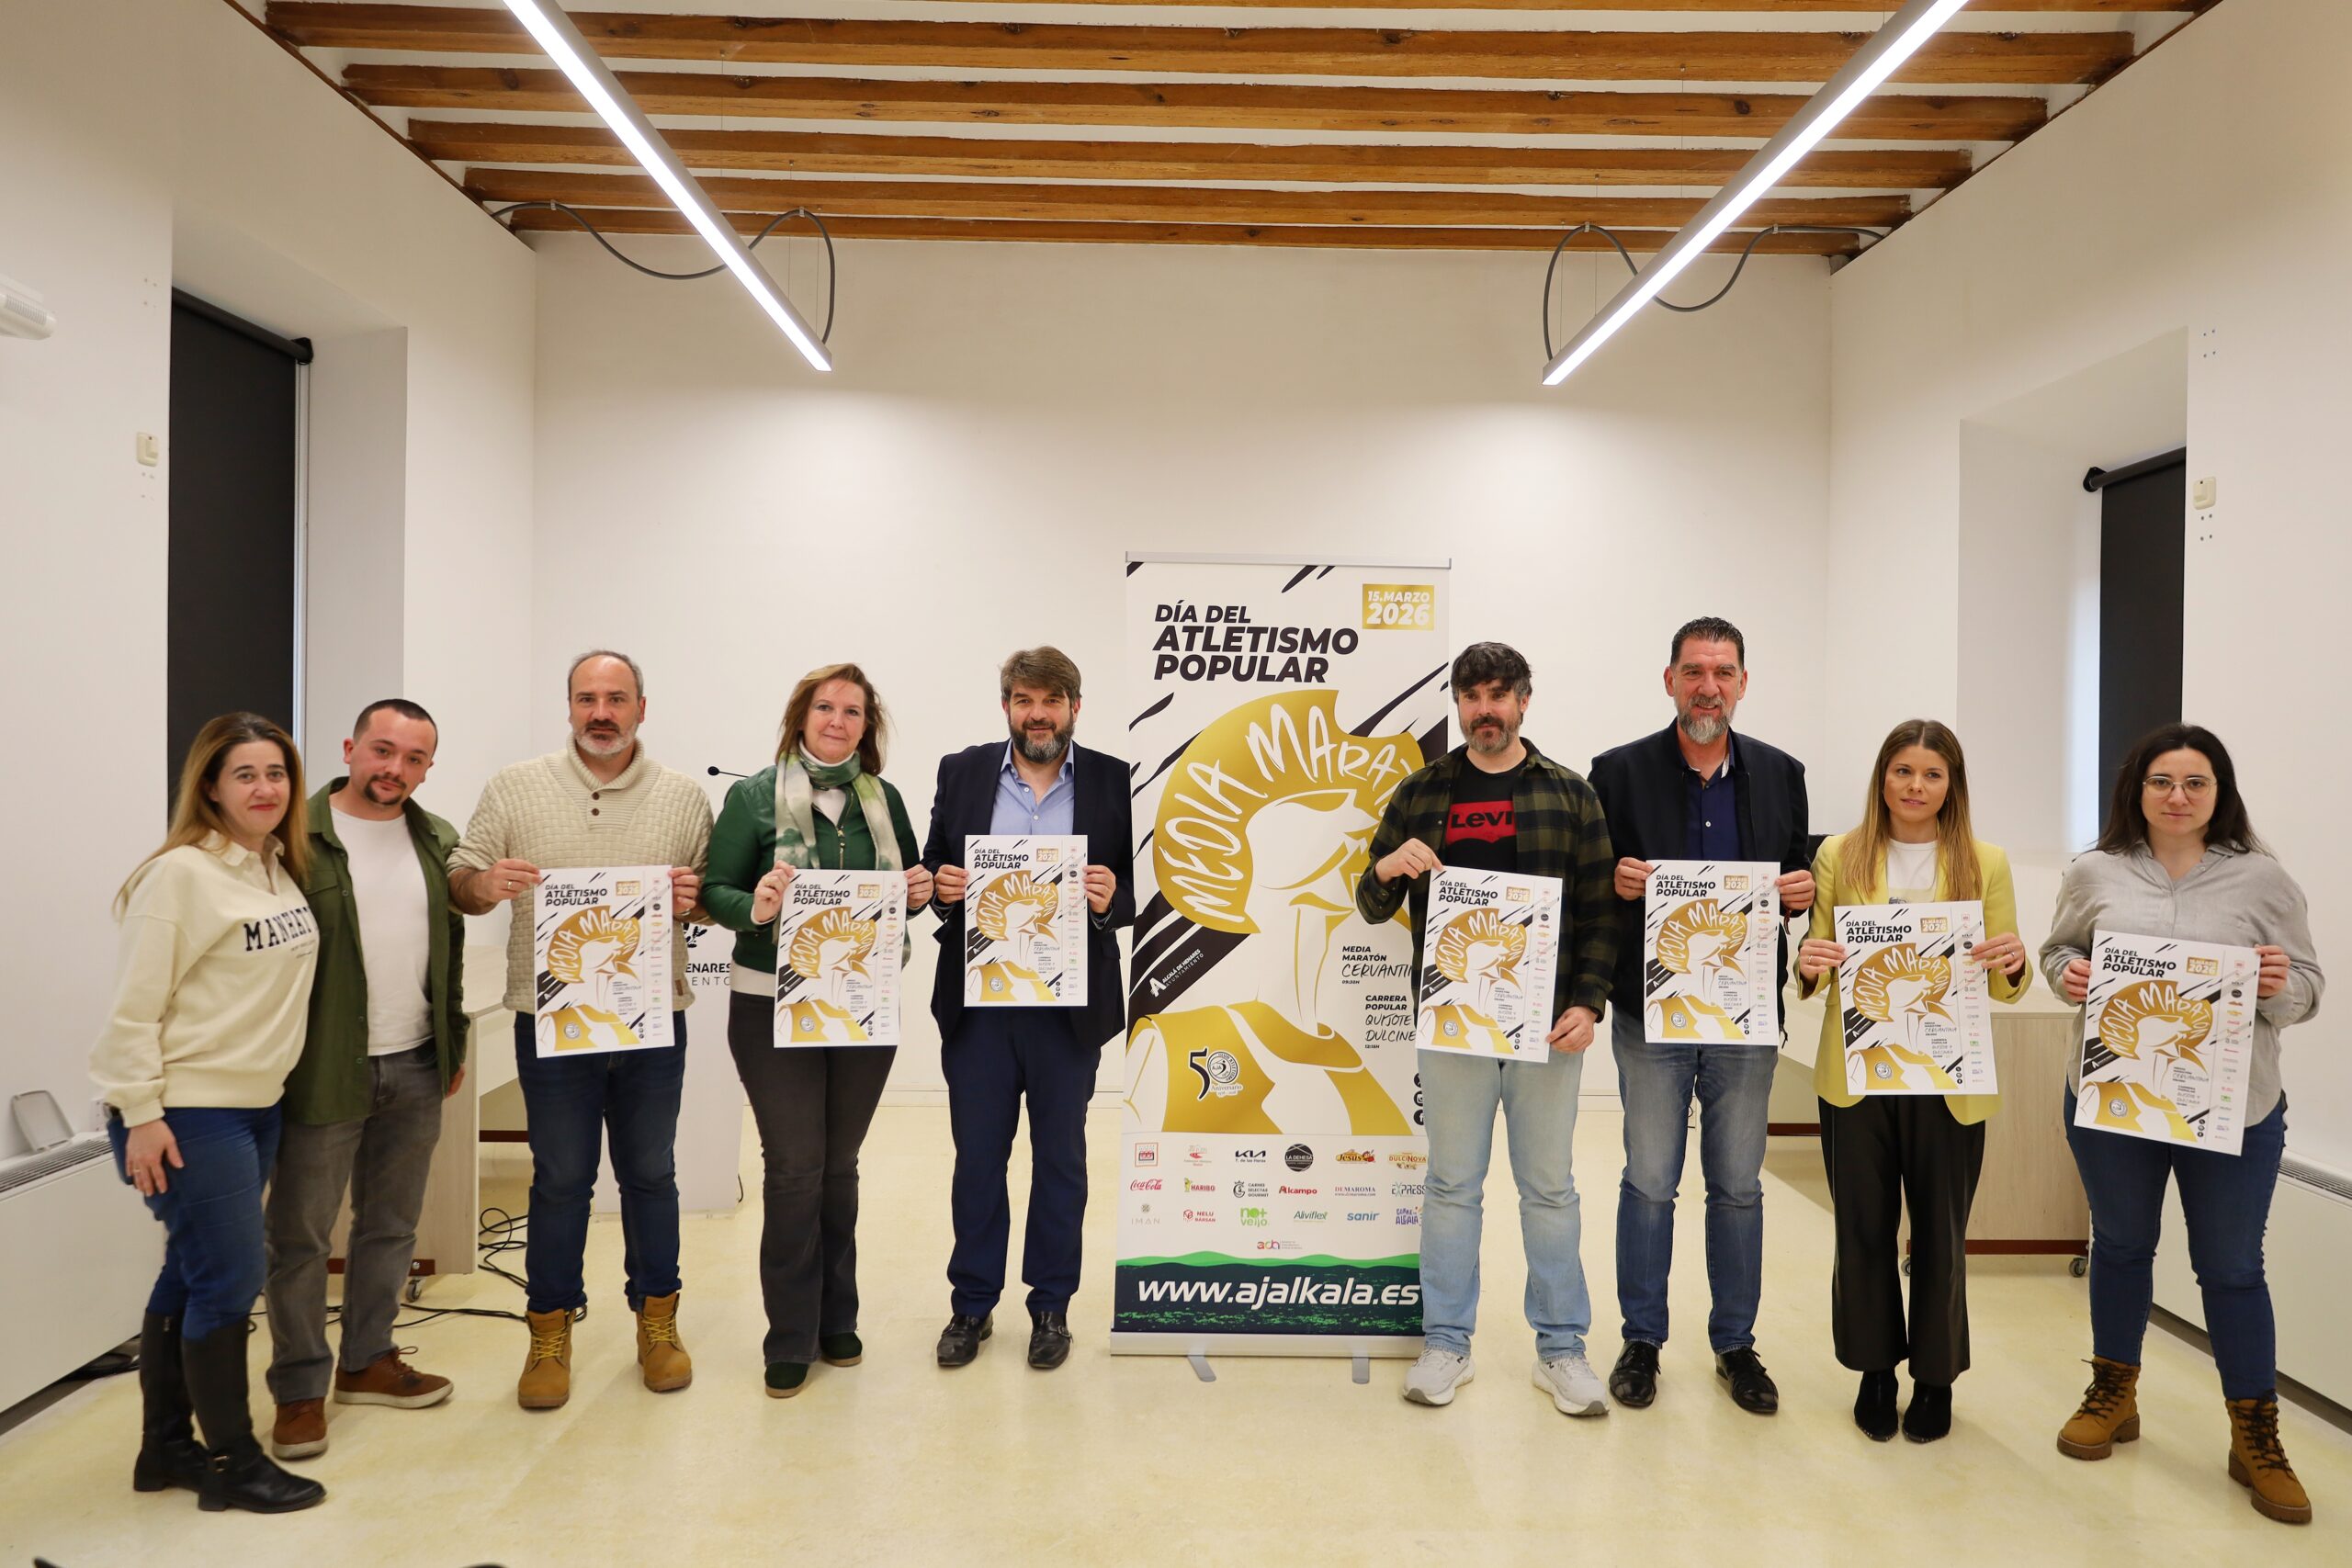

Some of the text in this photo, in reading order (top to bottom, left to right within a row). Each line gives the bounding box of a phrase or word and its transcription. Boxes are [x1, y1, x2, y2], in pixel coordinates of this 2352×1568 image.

[1368, 591, 1430, 603] 15.MARZO
[1155, 600, 1251, 624] DÍA DEL
[1366, 602, 1430, 626] 2026
[1153, 625, 1358, 655] ATLETISMO
[1154, 654, 1329, 683] POPULAR
[1159, 759, 1269, 923] MEDIA
[1656, 880, 1716, 889] ATLETISMO
[545, 888, 607, 898] ATLETISMO
[794, 889, 851, 898] ATLETISMO
[1439, 886, 1498, 899] ATLETISMO
[1656, 889, 1708, 897] POPULAR
[545, 897, 599, 907] POPULAR
[793, 897, 842, 906] POPULAR
[1438, 895, 1489, 907] POPULAR
[978, 890, 1011, 940] MEDIA
[1846, 919, 1860, 928] DÍA
[1846, 925, 1912, 935] ATLETISMO
[1922, 923, 1947, 932] 2026
[1847, 933, 1903, 944] POPULAR
[791, 927, 827, 977] MEDIA
[1657, 919, 1695, 973] MEDIA
[2105, 946, 2138, 957] DÍA DEL
[548, 929, 589, 982] MEDIA
[1342, 953, 1387, 962] MARATÓN
[1436, 927, 1474, 982] MEDIA
[685, 963, 730, 973] ENARES
[2102, 953, 2177, 971] ATLETISMO
[1166, 953, 1204, 987] AYUNTAMIENTO
[2102, 962, 2165, 978] POPULAR
[1855, 966, 1894, 1021] MEDIA
[1365, 1013, 1412, 1027] QUIJOTE
[2101, 998, 2146, 1059] MEDIA
[1365, 1029, 1416, 1043] DULCINE
[1235, 1149, 1266, 1158] KIA
[1279, 1185, 1317, 1195] Alcampo
[1347, 1212, 1380, 1221] sanir
[1138, 1276, 1419, 1310] www.ajalkala.es
